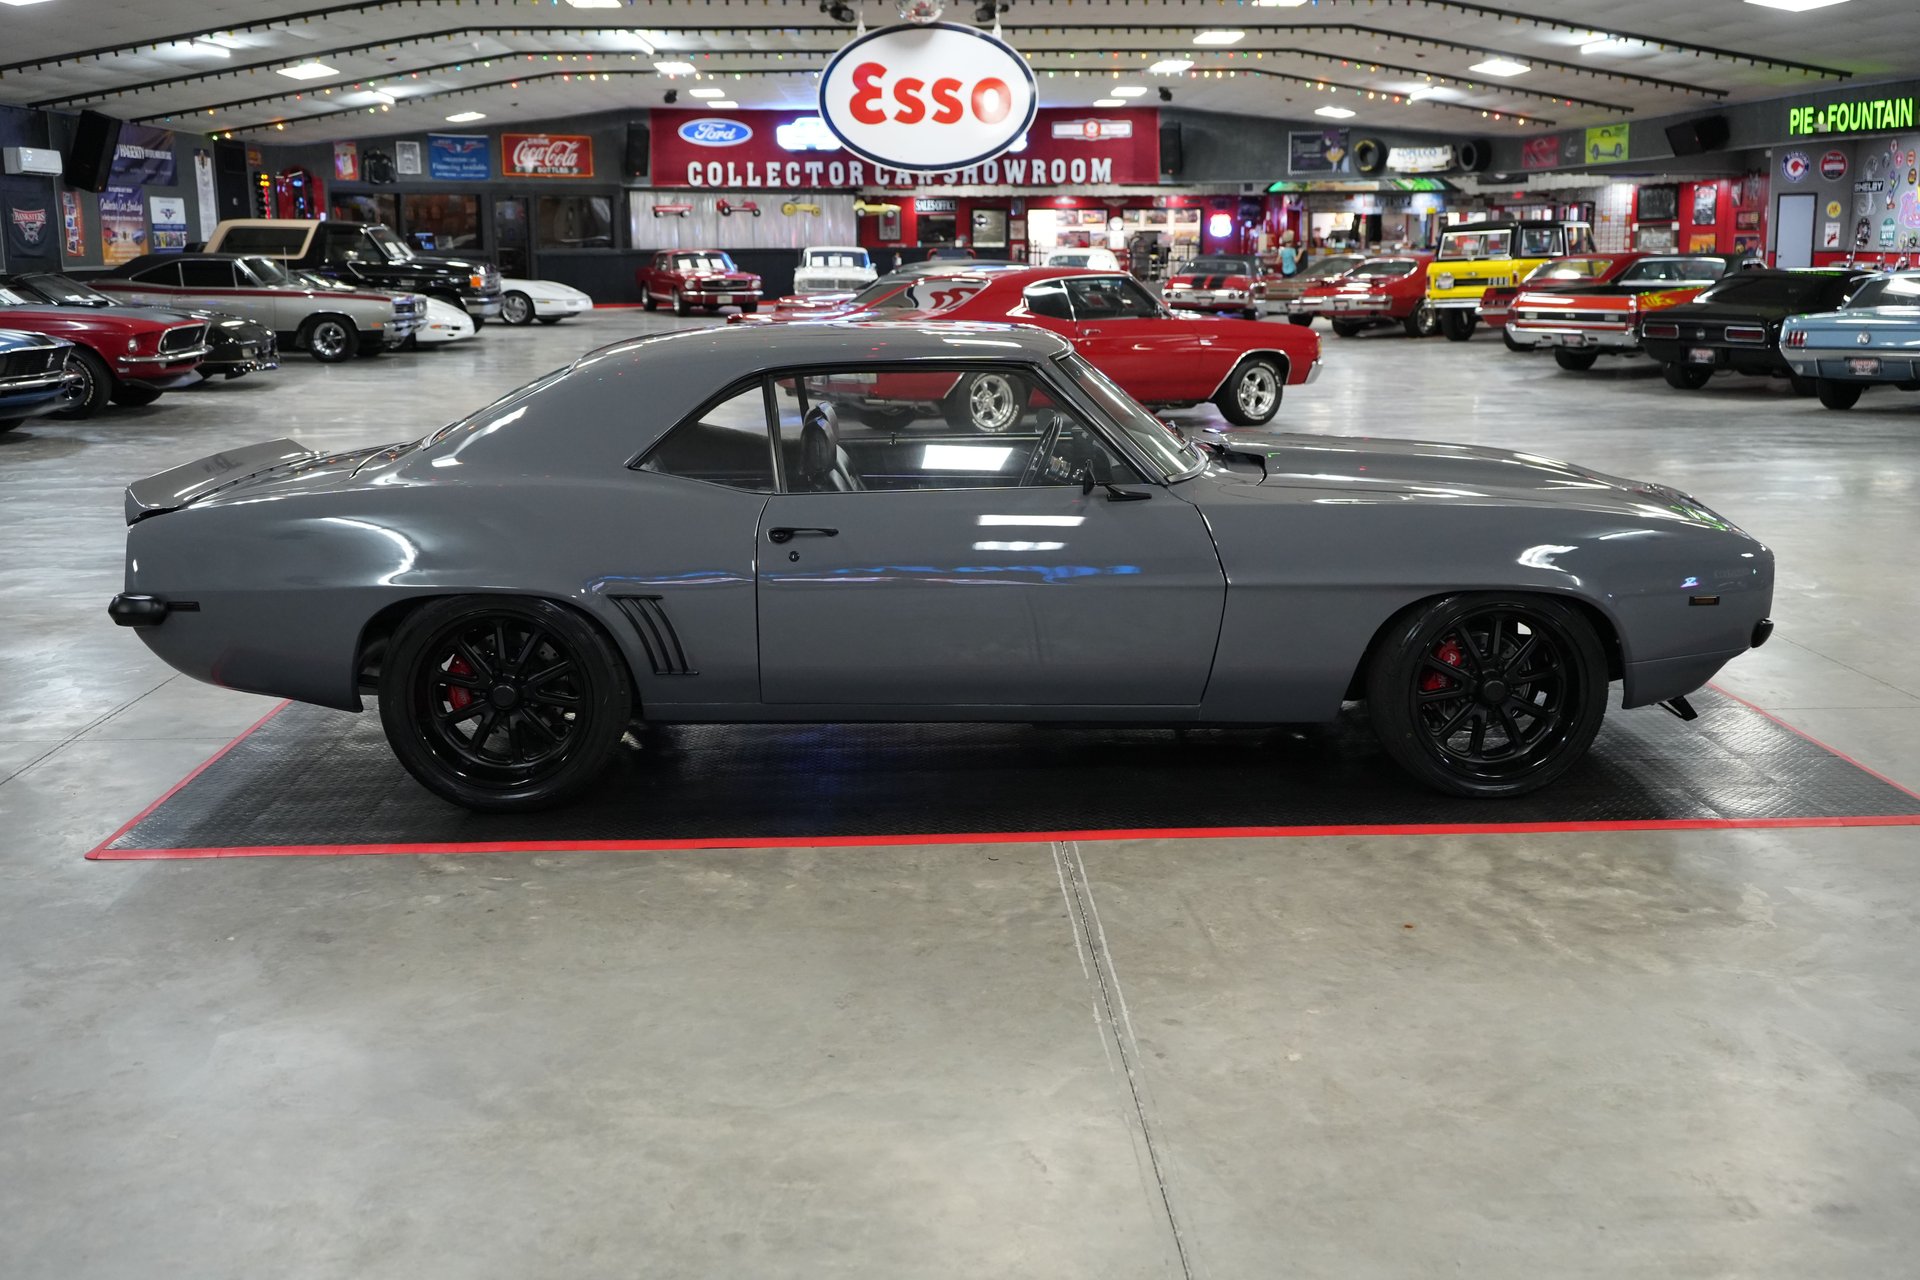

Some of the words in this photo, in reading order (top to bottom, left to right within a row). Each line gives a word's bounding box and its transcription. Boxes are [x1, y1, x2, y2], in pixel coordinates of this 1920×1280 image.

[1790, 107, 1814, 135] PIE
[1827, 97, 1913, 132] FOUNTAIN
[693, 122, 735, 140] Ford
[513, 140, 580, 167] Coca-Cola
[687, 161, 864, 188] COLLECTOR
[944, 158, 1112, 186] SHOWROOM
[1854, 181, 1883, 193] SHELBY
